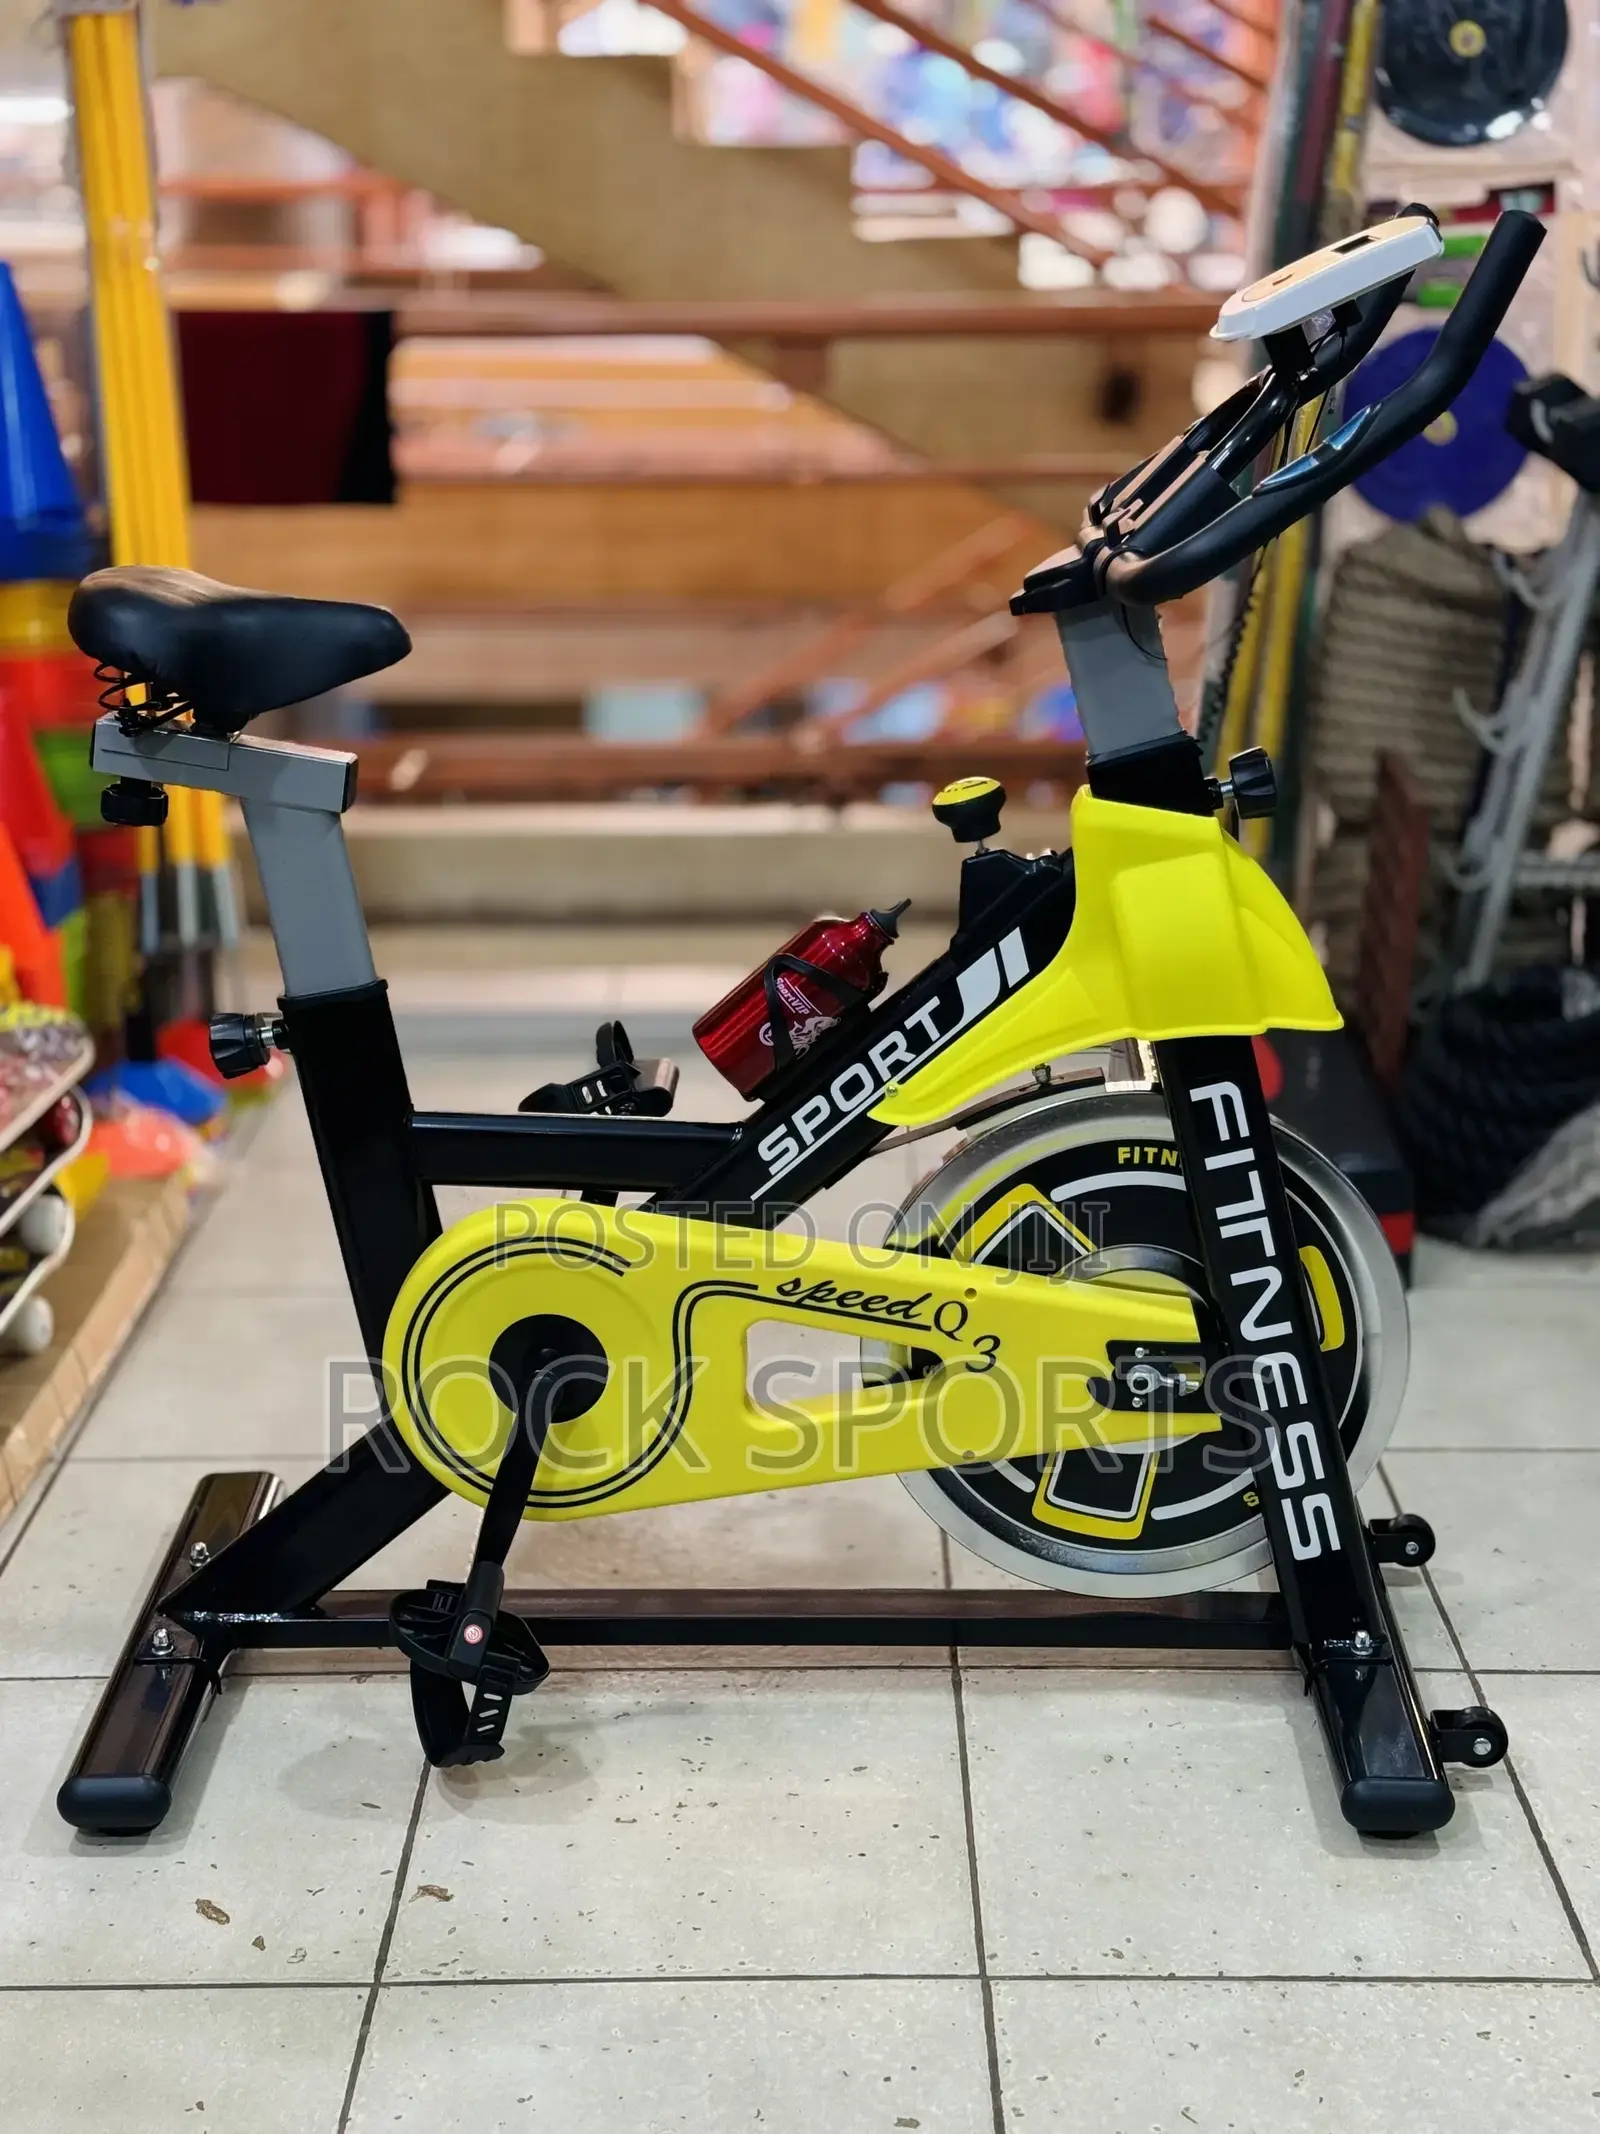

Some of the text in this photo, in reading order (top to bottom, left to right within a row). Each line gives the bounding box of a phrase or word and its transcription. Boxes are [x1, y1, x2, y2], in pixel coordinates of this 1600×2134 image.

[757, 995, 941, 1177] SPORT
[1117, 1146, 1180, 1168] FITN
[776, 1277, 933, 1320] speed
[1190, 1081, 1341, 1561] FITNESS
